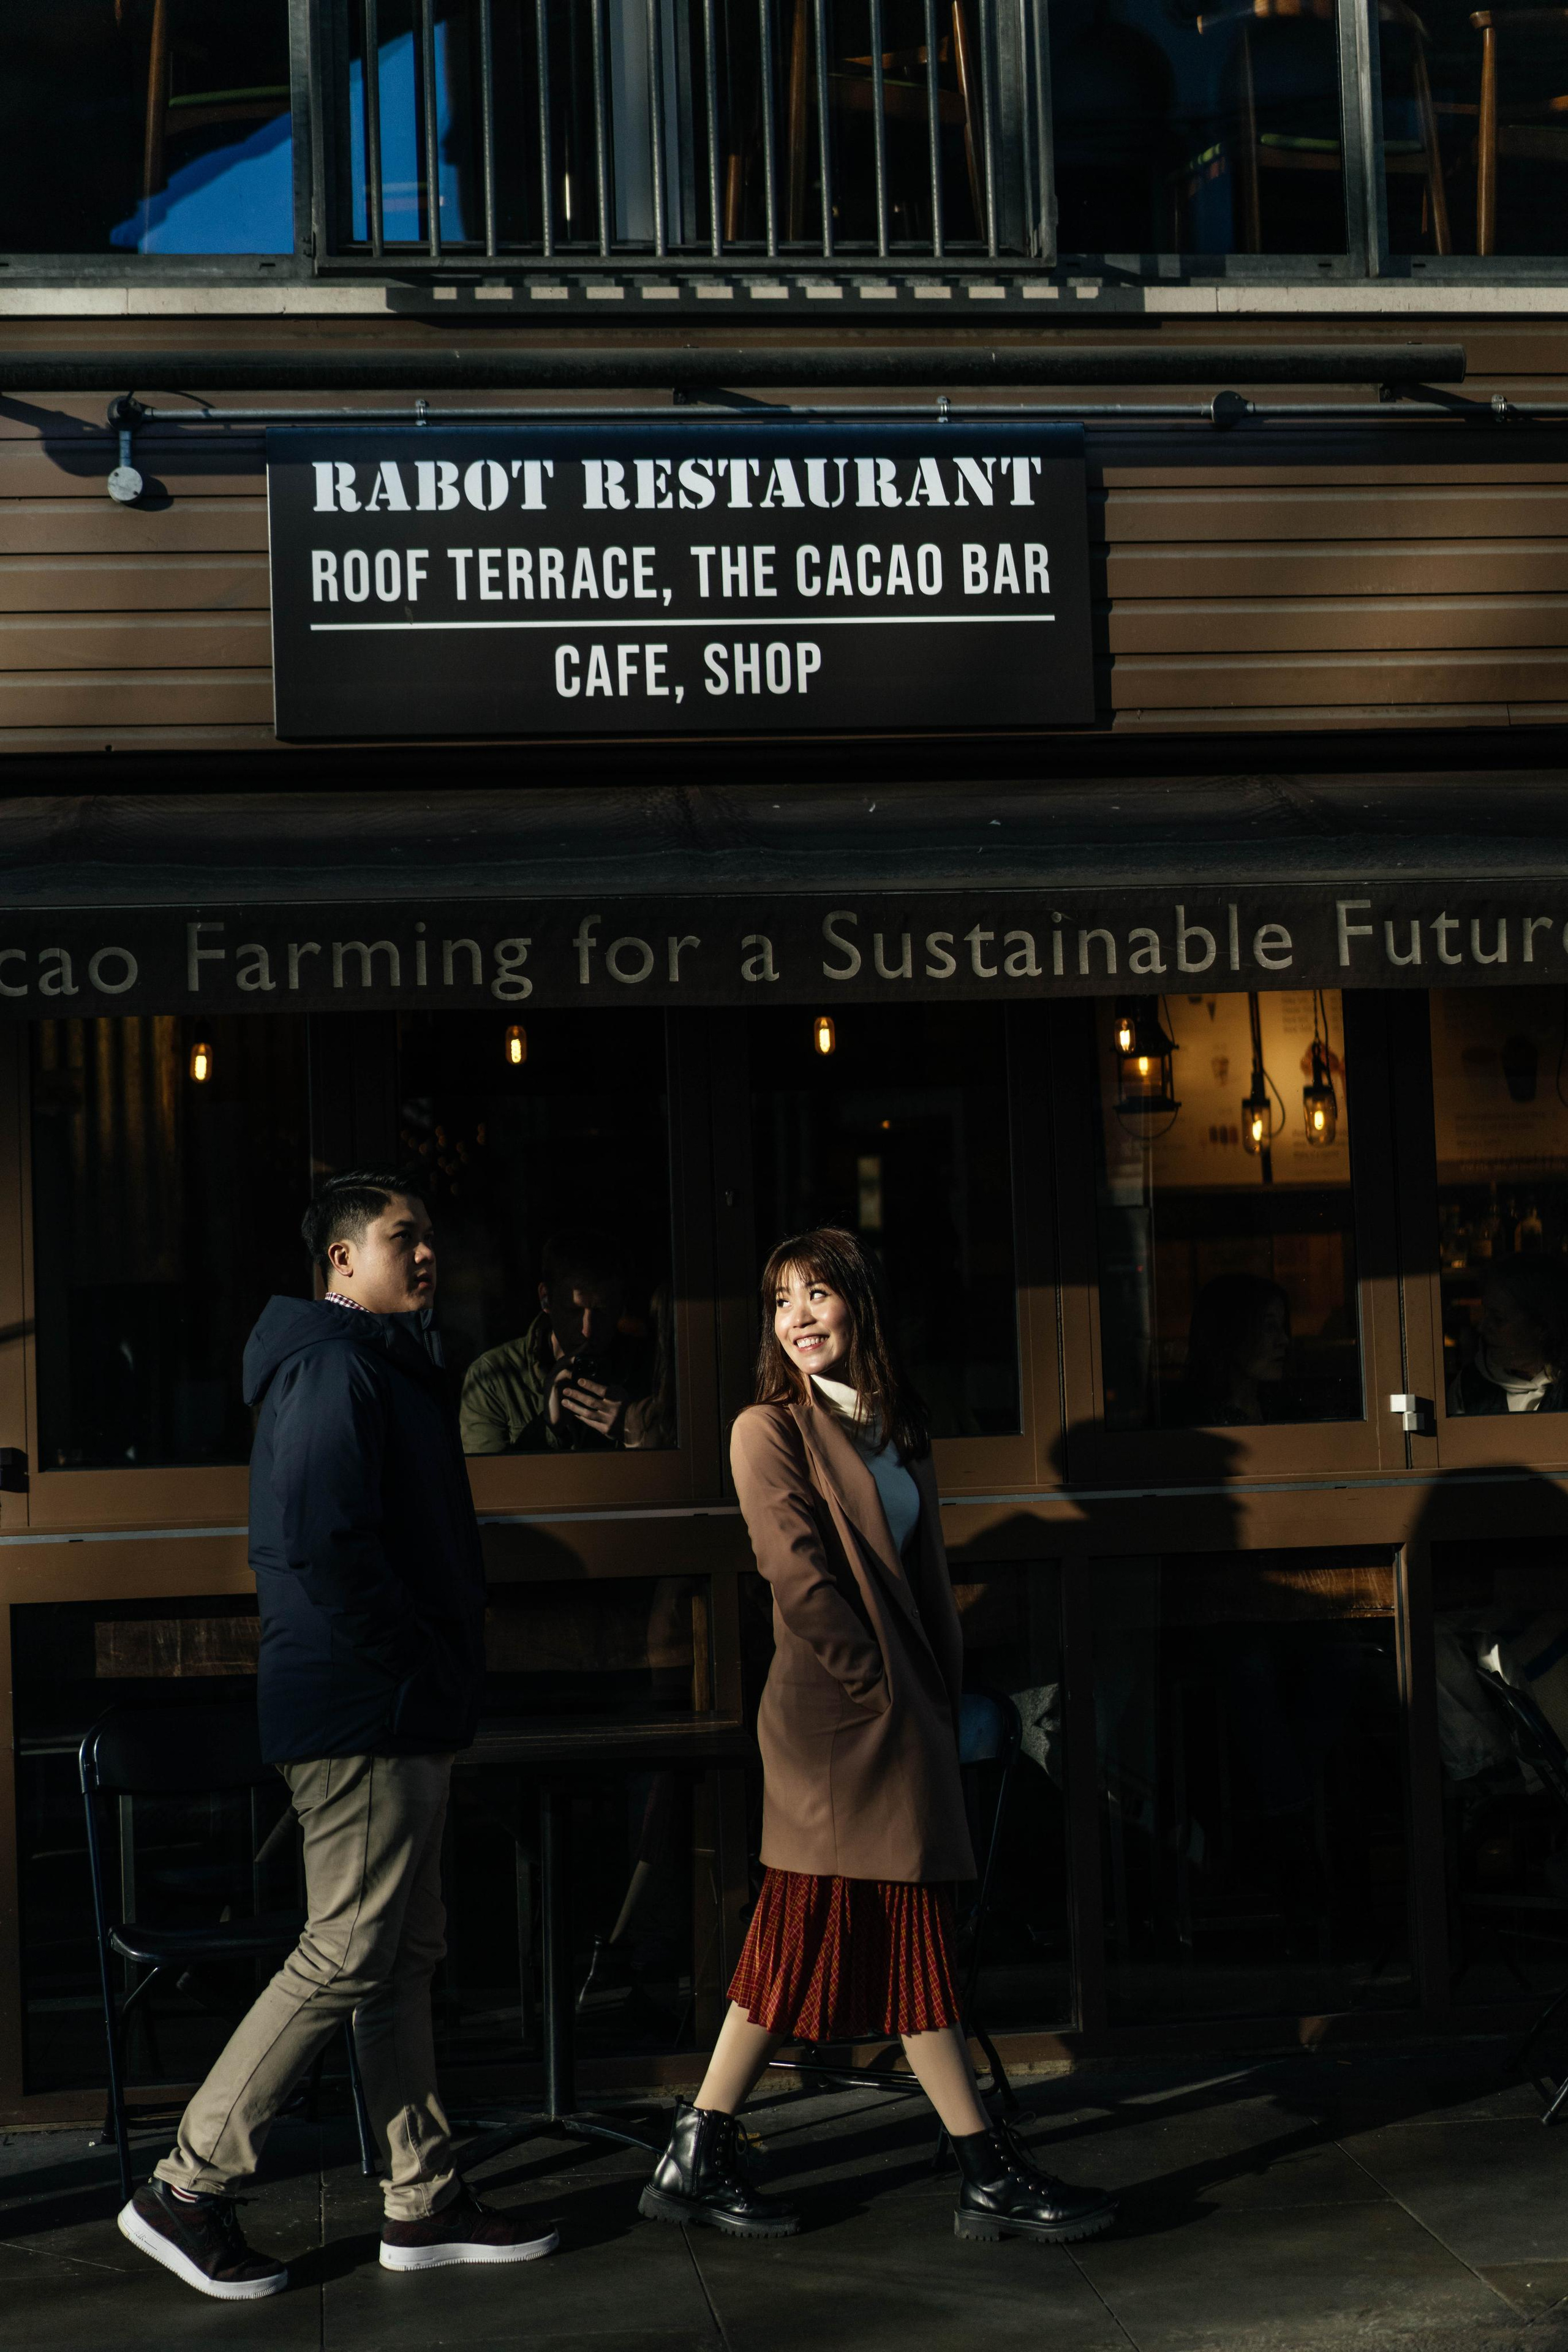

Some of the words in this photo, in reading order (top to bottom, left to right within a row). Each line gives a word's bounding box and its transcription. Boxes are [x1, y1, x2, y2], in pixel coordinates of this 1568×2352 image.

[312, 460, 554, 513] RABOT
[581, 457, 1041, 510] RESTAURANT
[312, 549, 429, 602] ROOF
[447, 546, 672, 606] TERRACE,
[690, 546, 777, 597] THE
[796, 543, 943, 597] CACAO
[962, 543, 1050, 594] BAR
[555, 644, 684, 704] CAFE,
[704, 642, 821, 695] SHOP
[186, 921, 533, 1001] Farming
[572, 914, 701, 984] for
[741, 934, 780, 982] a
[821, 903, 1294, 980] Sustainable
[1336, 899, 1568, 967] Futur
